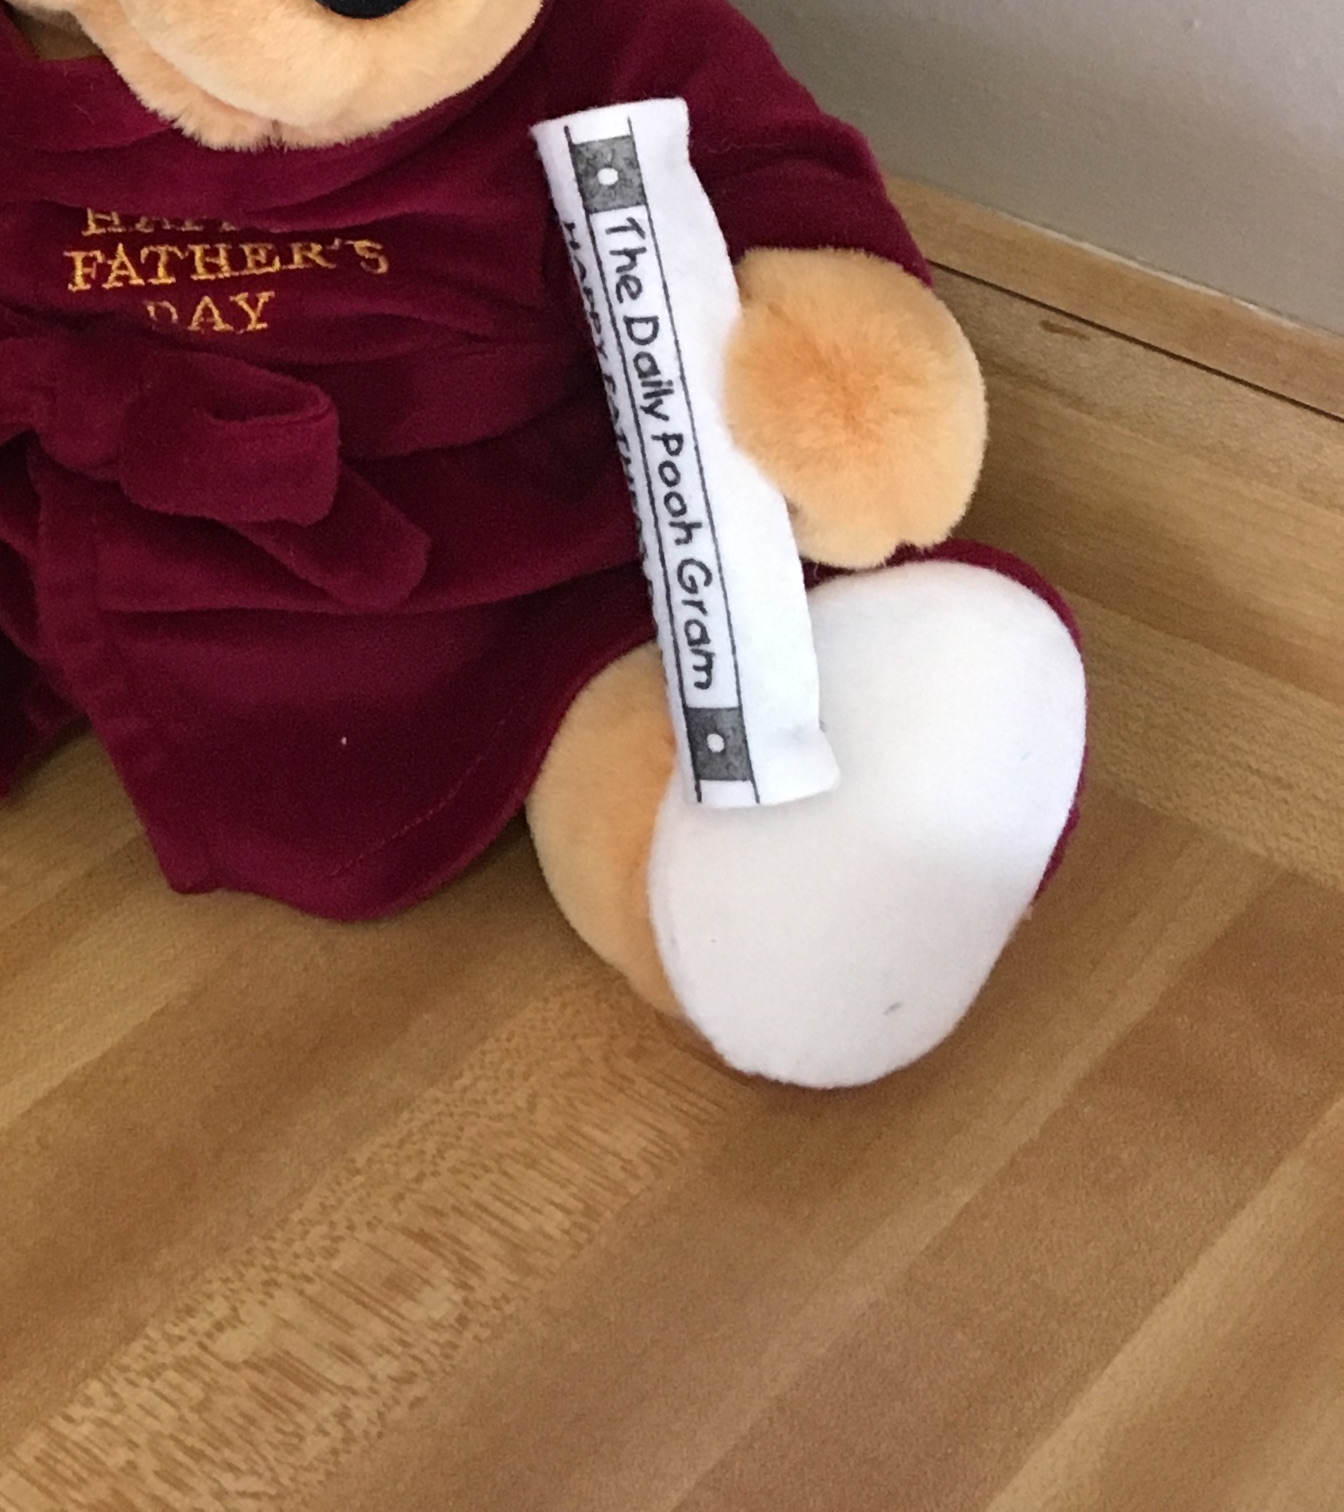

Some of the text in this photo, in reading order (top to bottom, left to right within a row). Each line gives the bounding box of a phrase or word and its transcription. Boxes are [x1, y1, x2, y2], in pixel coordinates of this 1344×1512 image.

[62, 238, 390, 292] FATHER'S
[604, 216, 647, 304] The
[623, 314, 675, 422] Daily
[650, 431, 704, 547] Pooh
[676, 557, 716, 691] Gram
